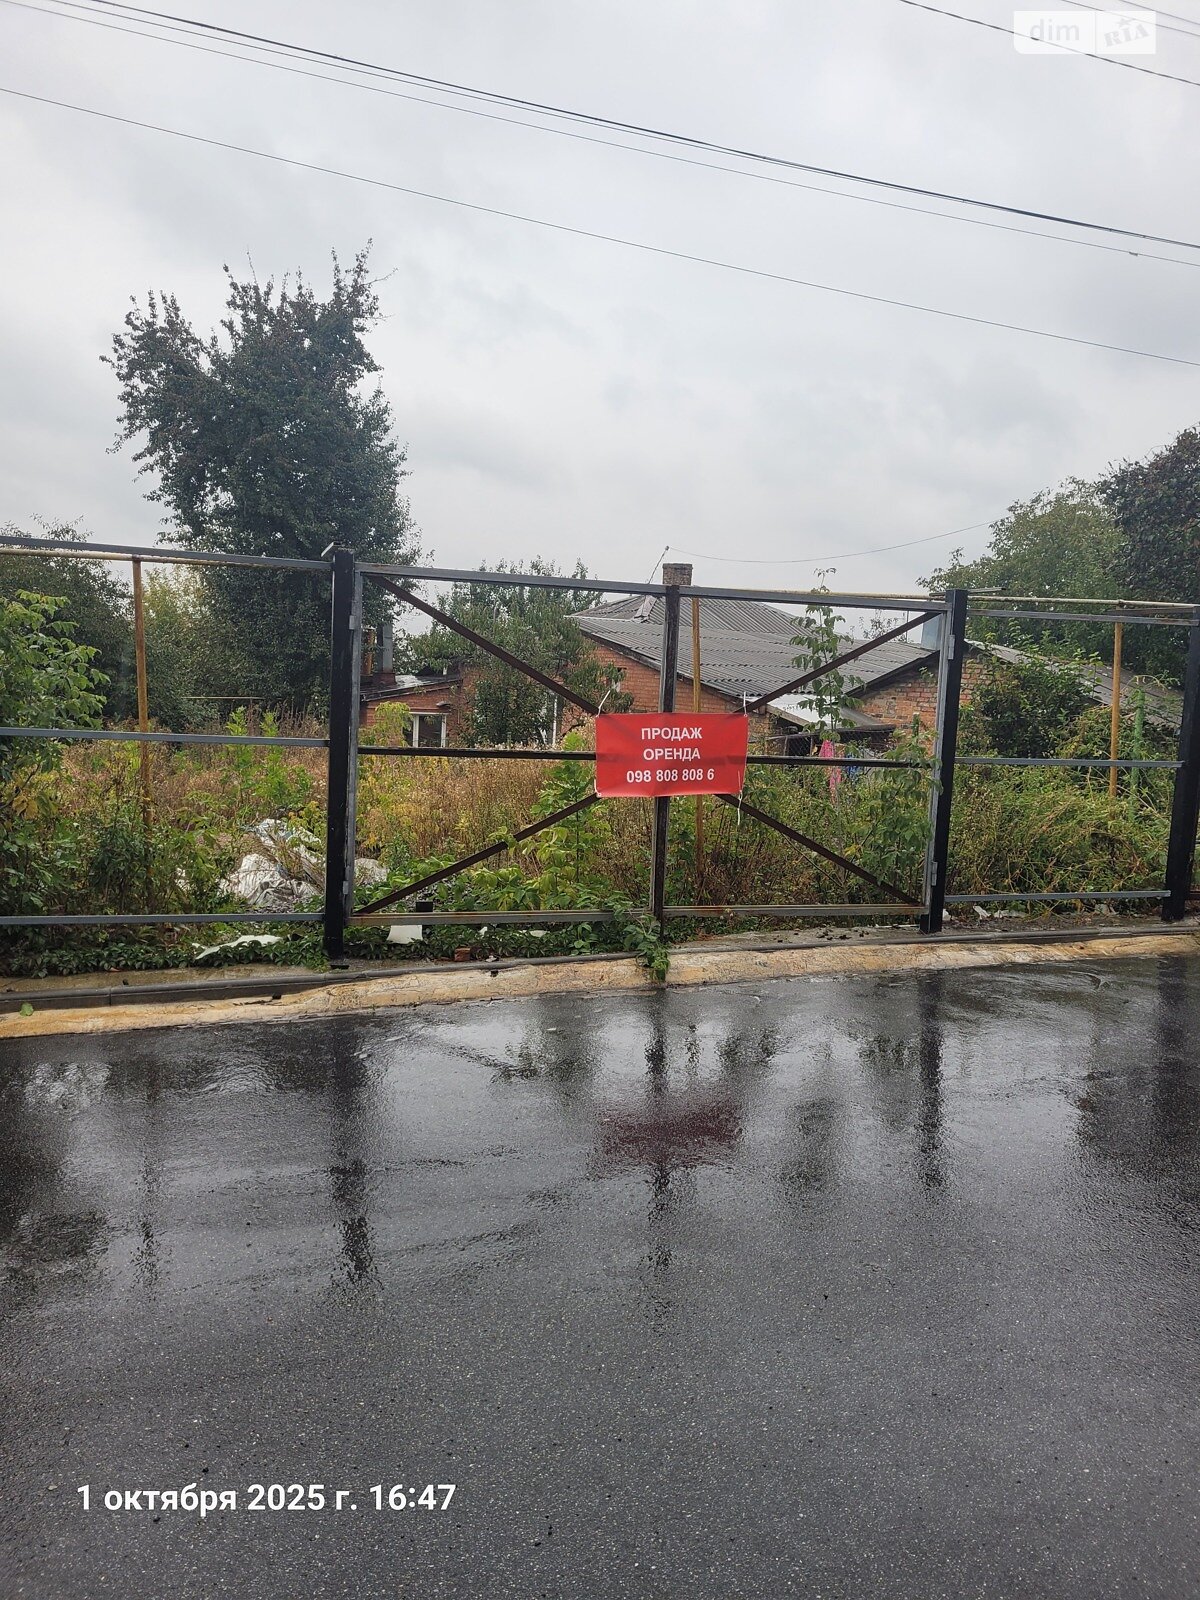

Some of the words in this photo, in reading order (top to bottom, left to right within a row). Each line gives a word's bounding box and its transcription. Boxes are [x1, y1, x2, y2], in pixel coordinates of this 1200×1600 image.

[641, 727, 703, 741] ПРОДАЖ
[643, 747, 701, 762] ОРЕНДА
[626, 770, 652, 783] 098
[656, 769, 678, 782] 808
[682, 768, 704, 781] 808
[707, 768, 715, 781] 6
